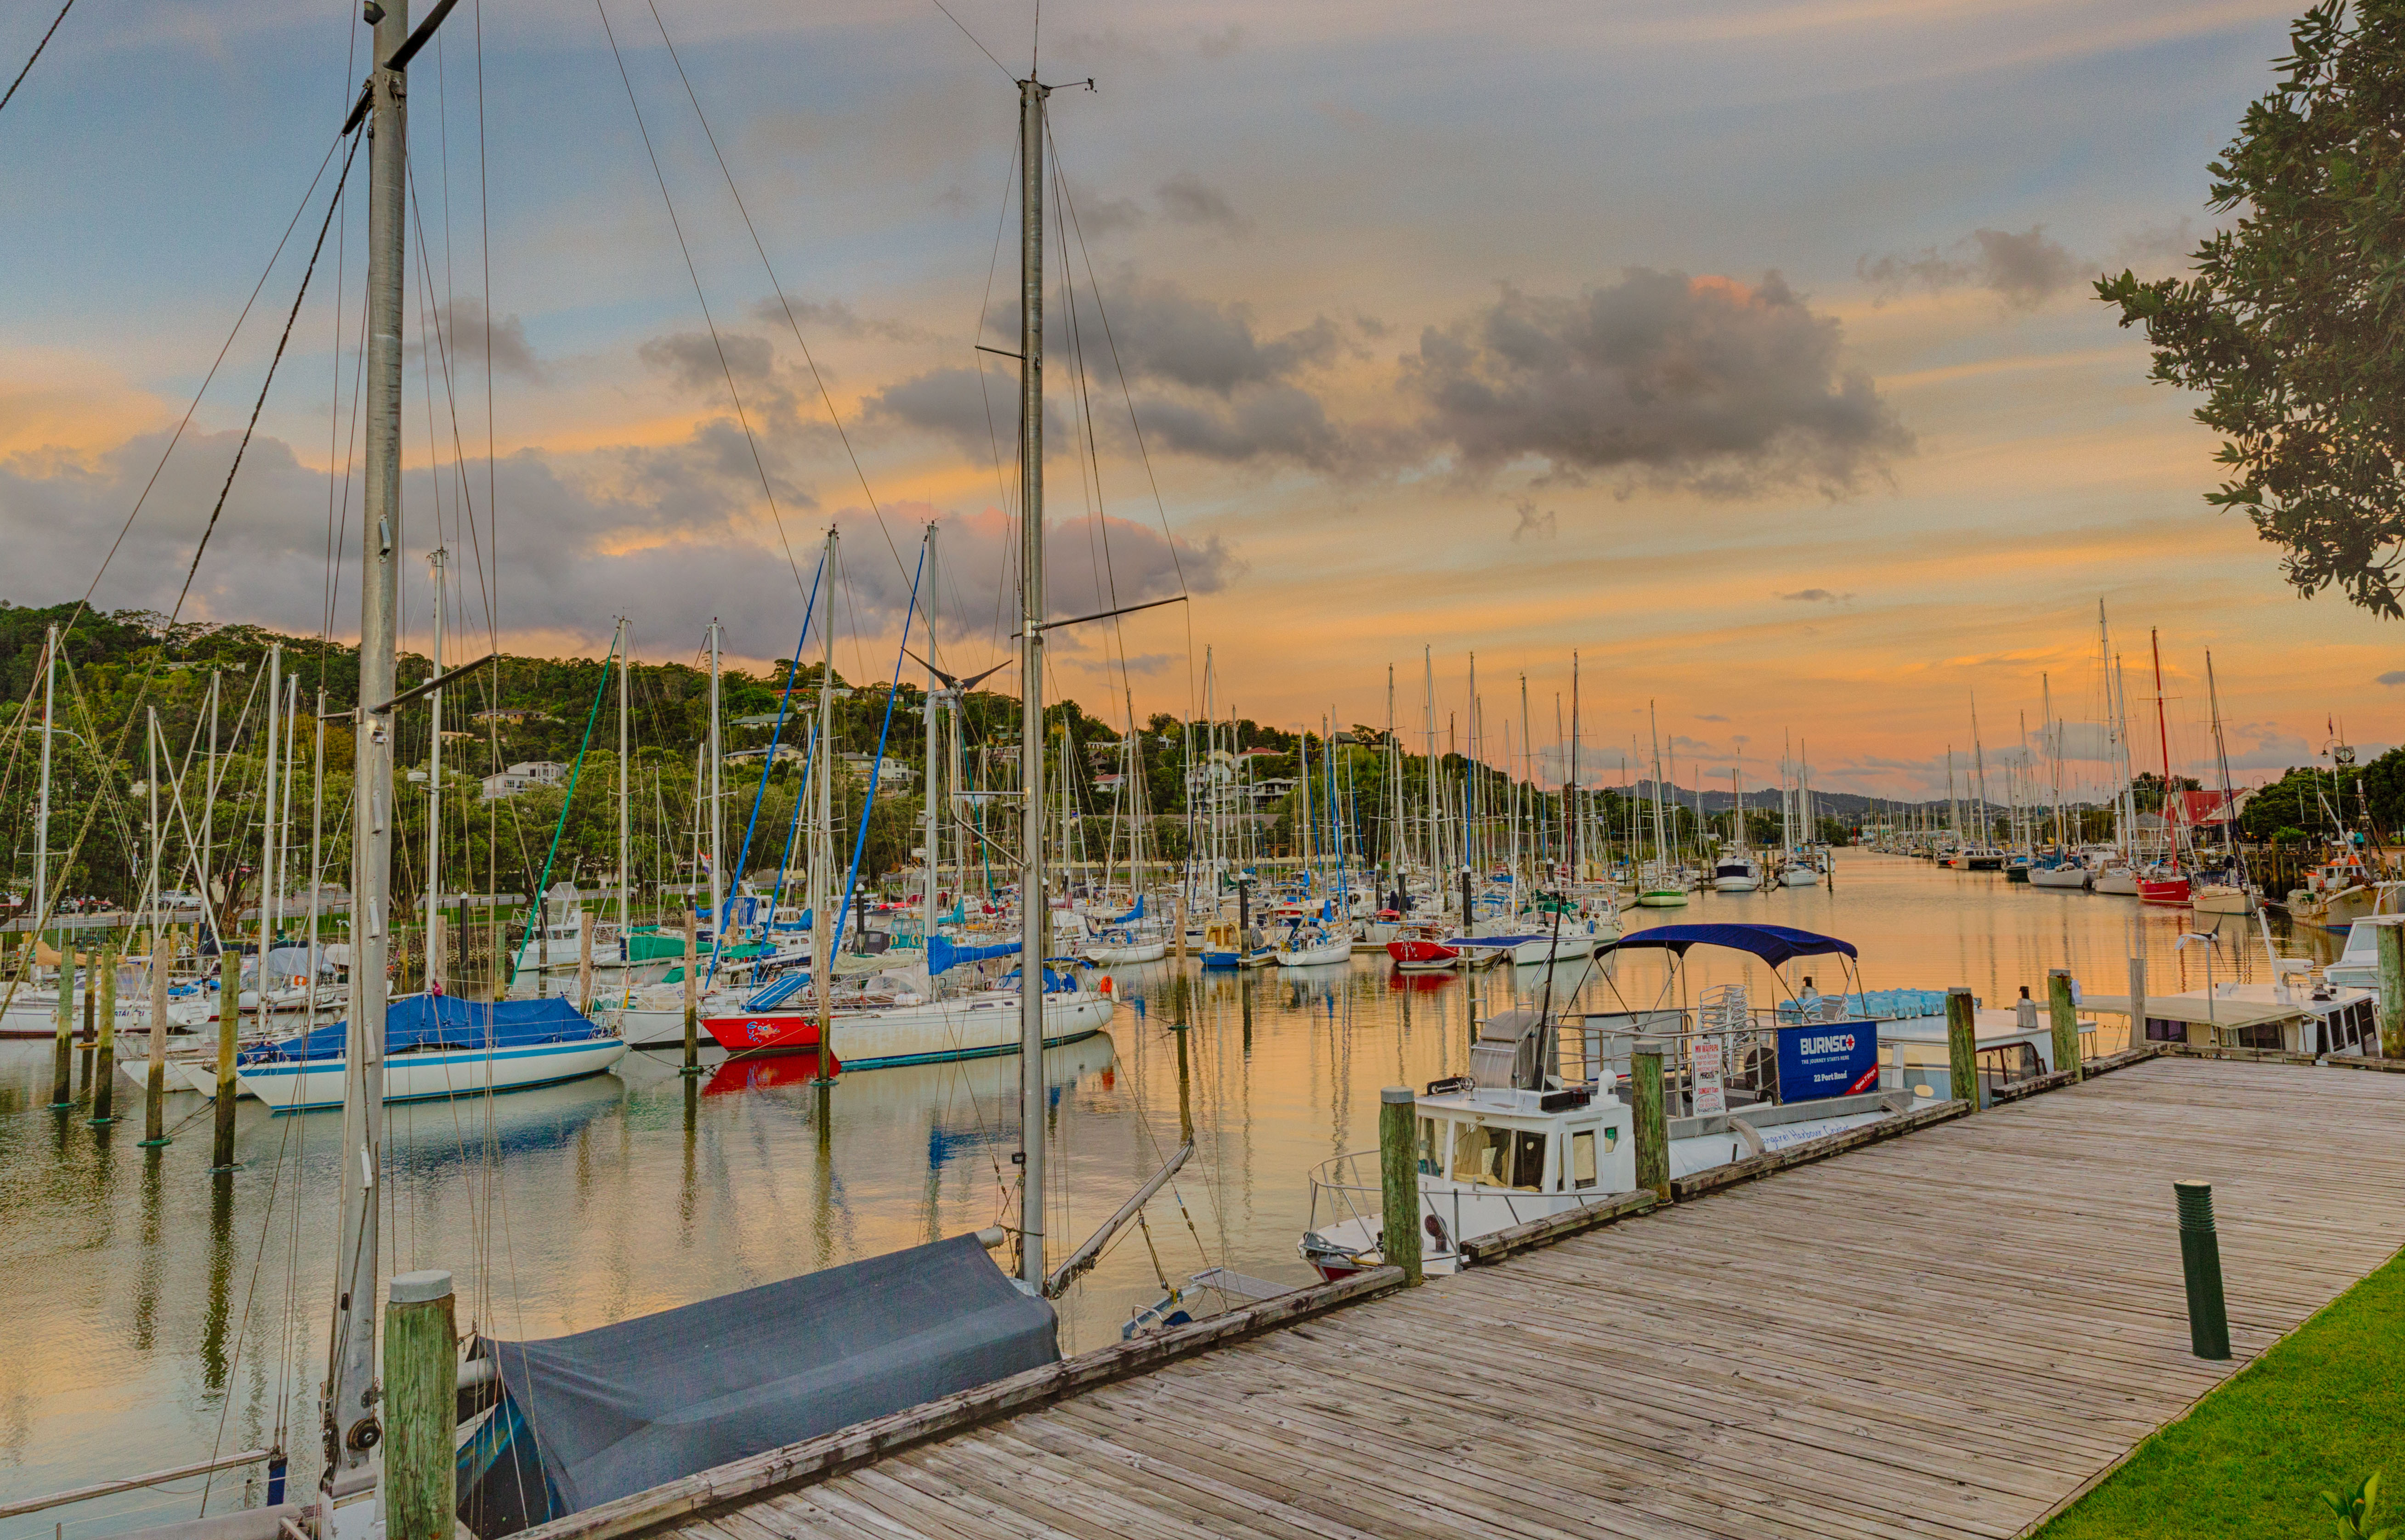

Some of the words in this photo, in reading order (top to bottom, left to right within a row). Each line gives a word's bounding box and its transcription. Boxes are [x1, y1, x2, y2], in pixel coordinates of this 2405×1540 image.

[1702, 1044, 1719, 1053] WAIPAPA
[1800, 1034, 1855, 1055] BURNSCO
[1834, 1070, 1847, 1080] Road
[1855, 1079, 1865, 1090] Open
[1866, 1069, 1876, 1080] Days
[1762, 1132, 1790, 1149] angarei
[1788, 1129, 1822, 1141] Harbour
